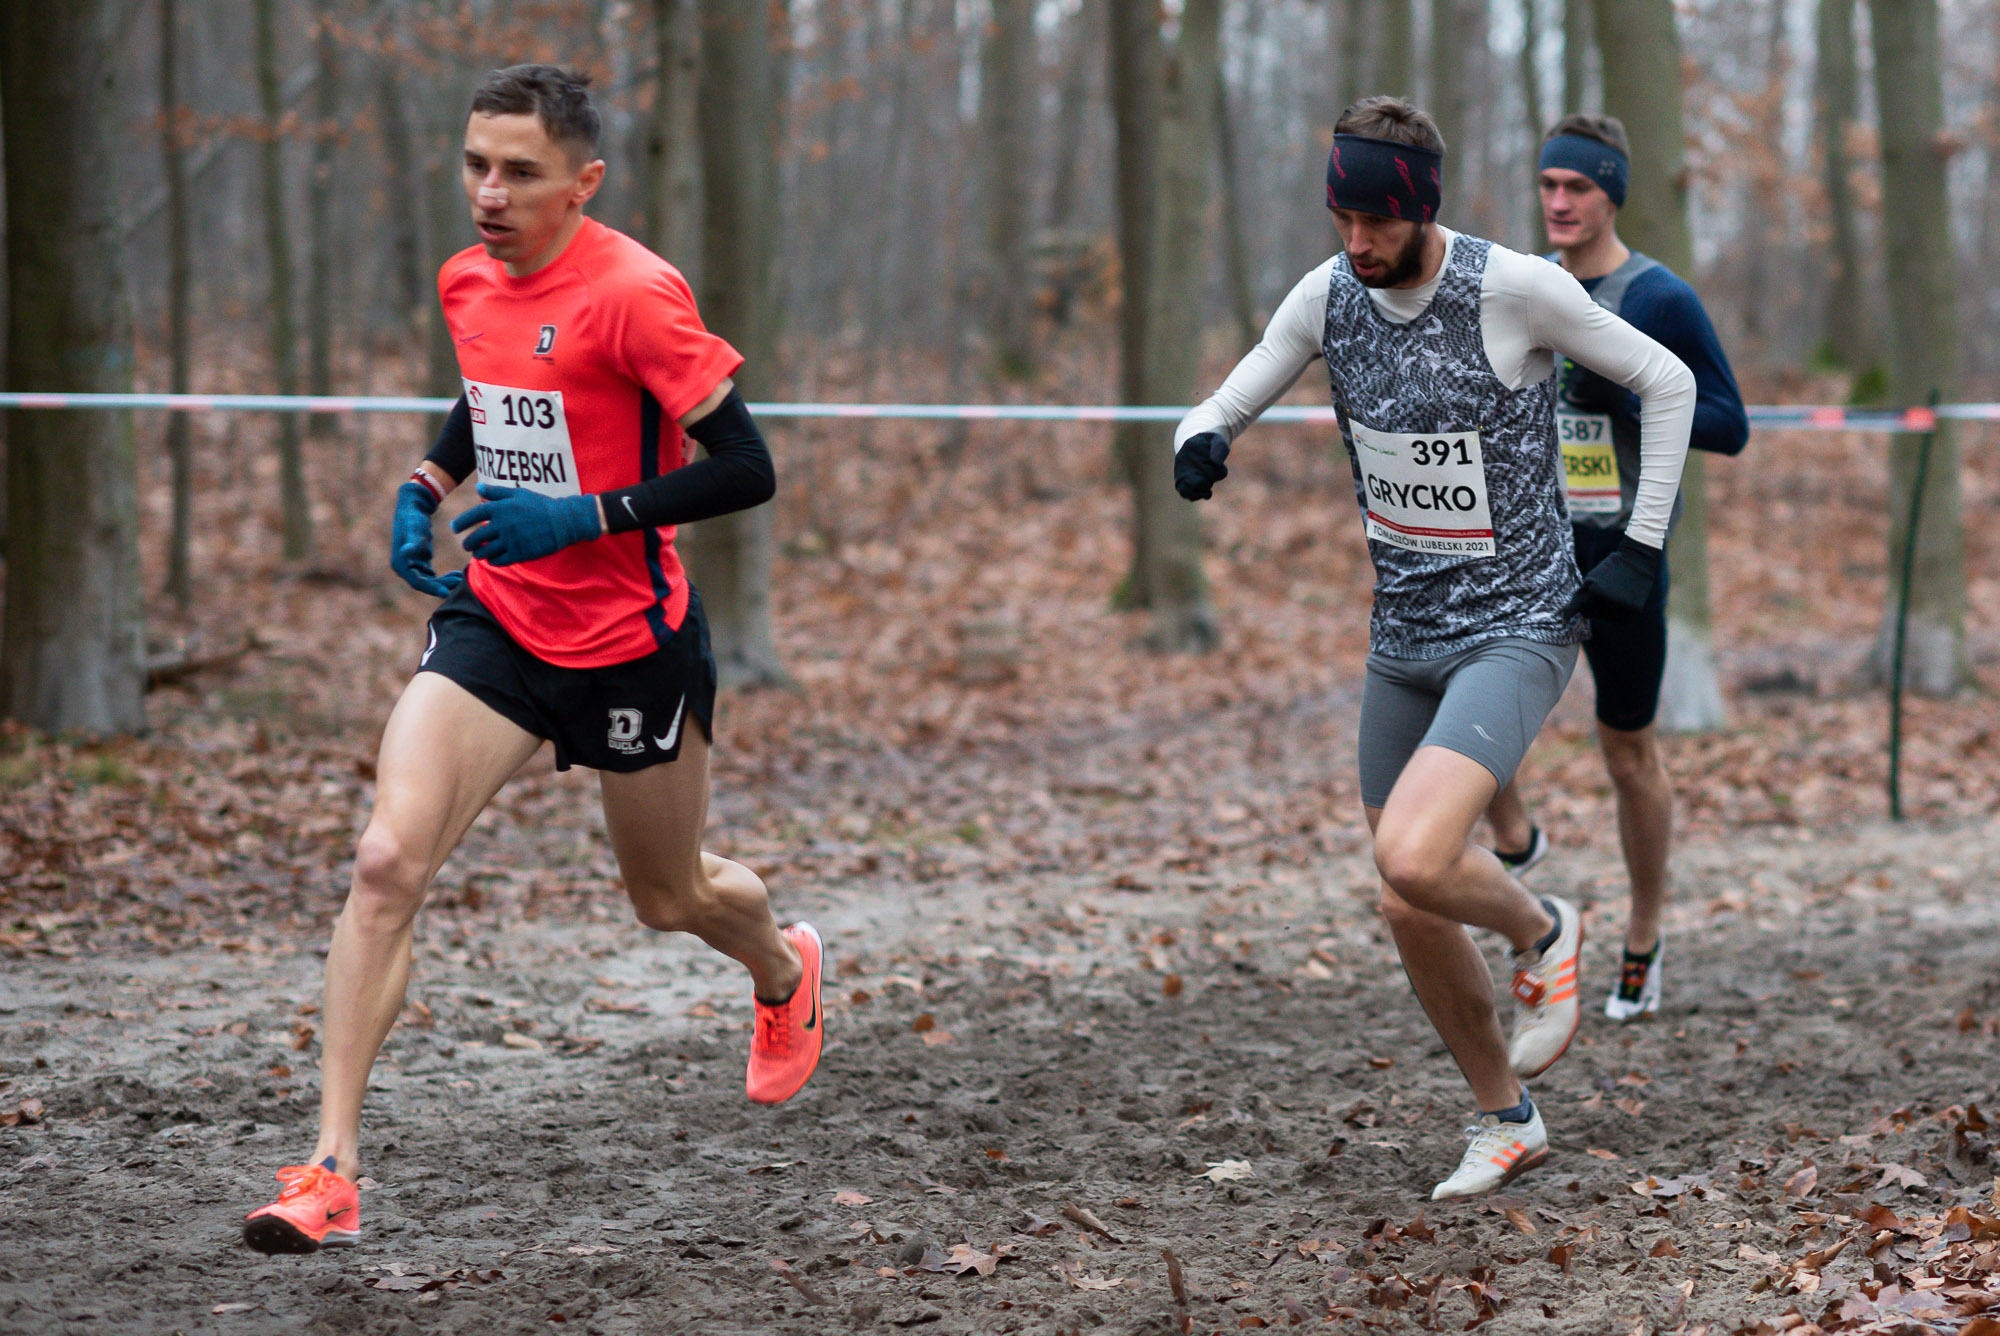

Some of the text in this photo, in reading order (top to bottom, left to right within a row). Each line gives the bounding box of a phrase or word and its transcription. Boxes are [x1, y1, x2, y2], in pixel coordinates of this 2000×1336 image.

[502, 394, 555, 429] 103
[1562, 420, 1604, 440] 587
[1411, 439, 1473, 466] 391
[1368, 473, 1477, 512] GRYCKO
[1373, 524, 1418, 548] TOMASZÓW
[1420, 540, 1463, 551] LUBELSKI
[1465, 542, 1489, 551] 2021
